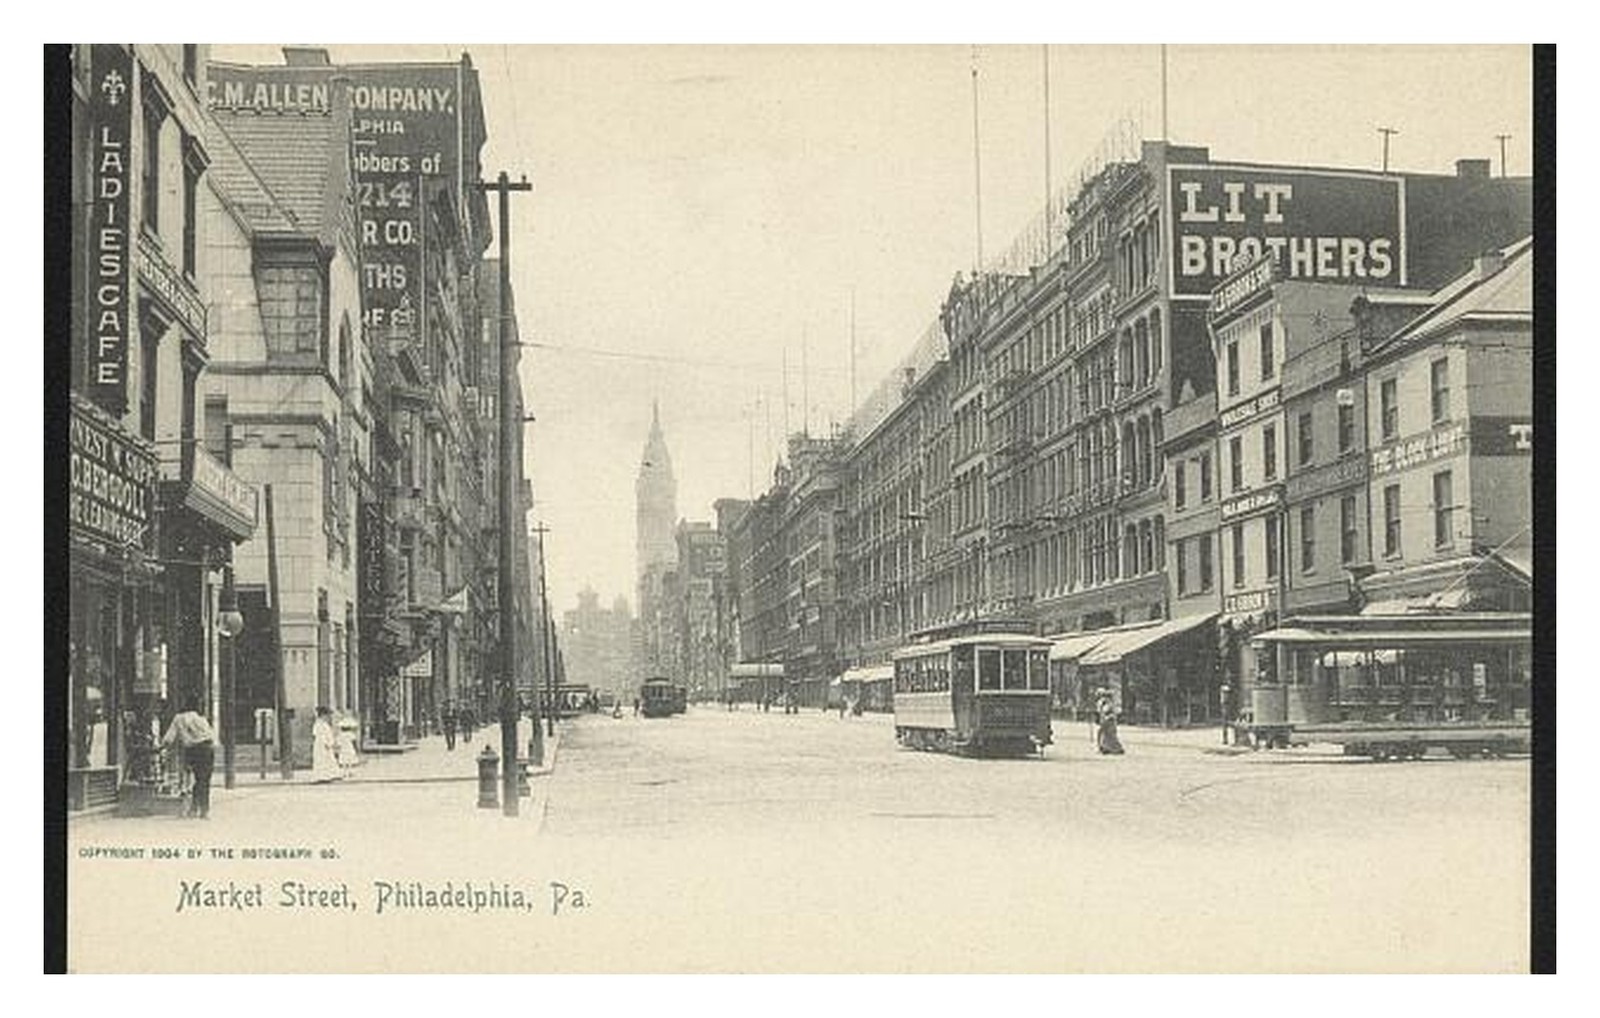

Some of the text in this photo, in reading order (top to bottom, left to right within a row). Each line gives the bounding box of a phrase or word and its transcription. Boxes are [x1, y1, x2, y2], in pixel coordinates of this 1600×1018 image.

[421, 152, 442, 174] of
[1180, 182, 1293, 223] LIT
[385, 220, 417, 245] CO.
[97, 125, 124, 384] LADIES CAFE
[1181, 234, 1393, 278] BROTHERS
